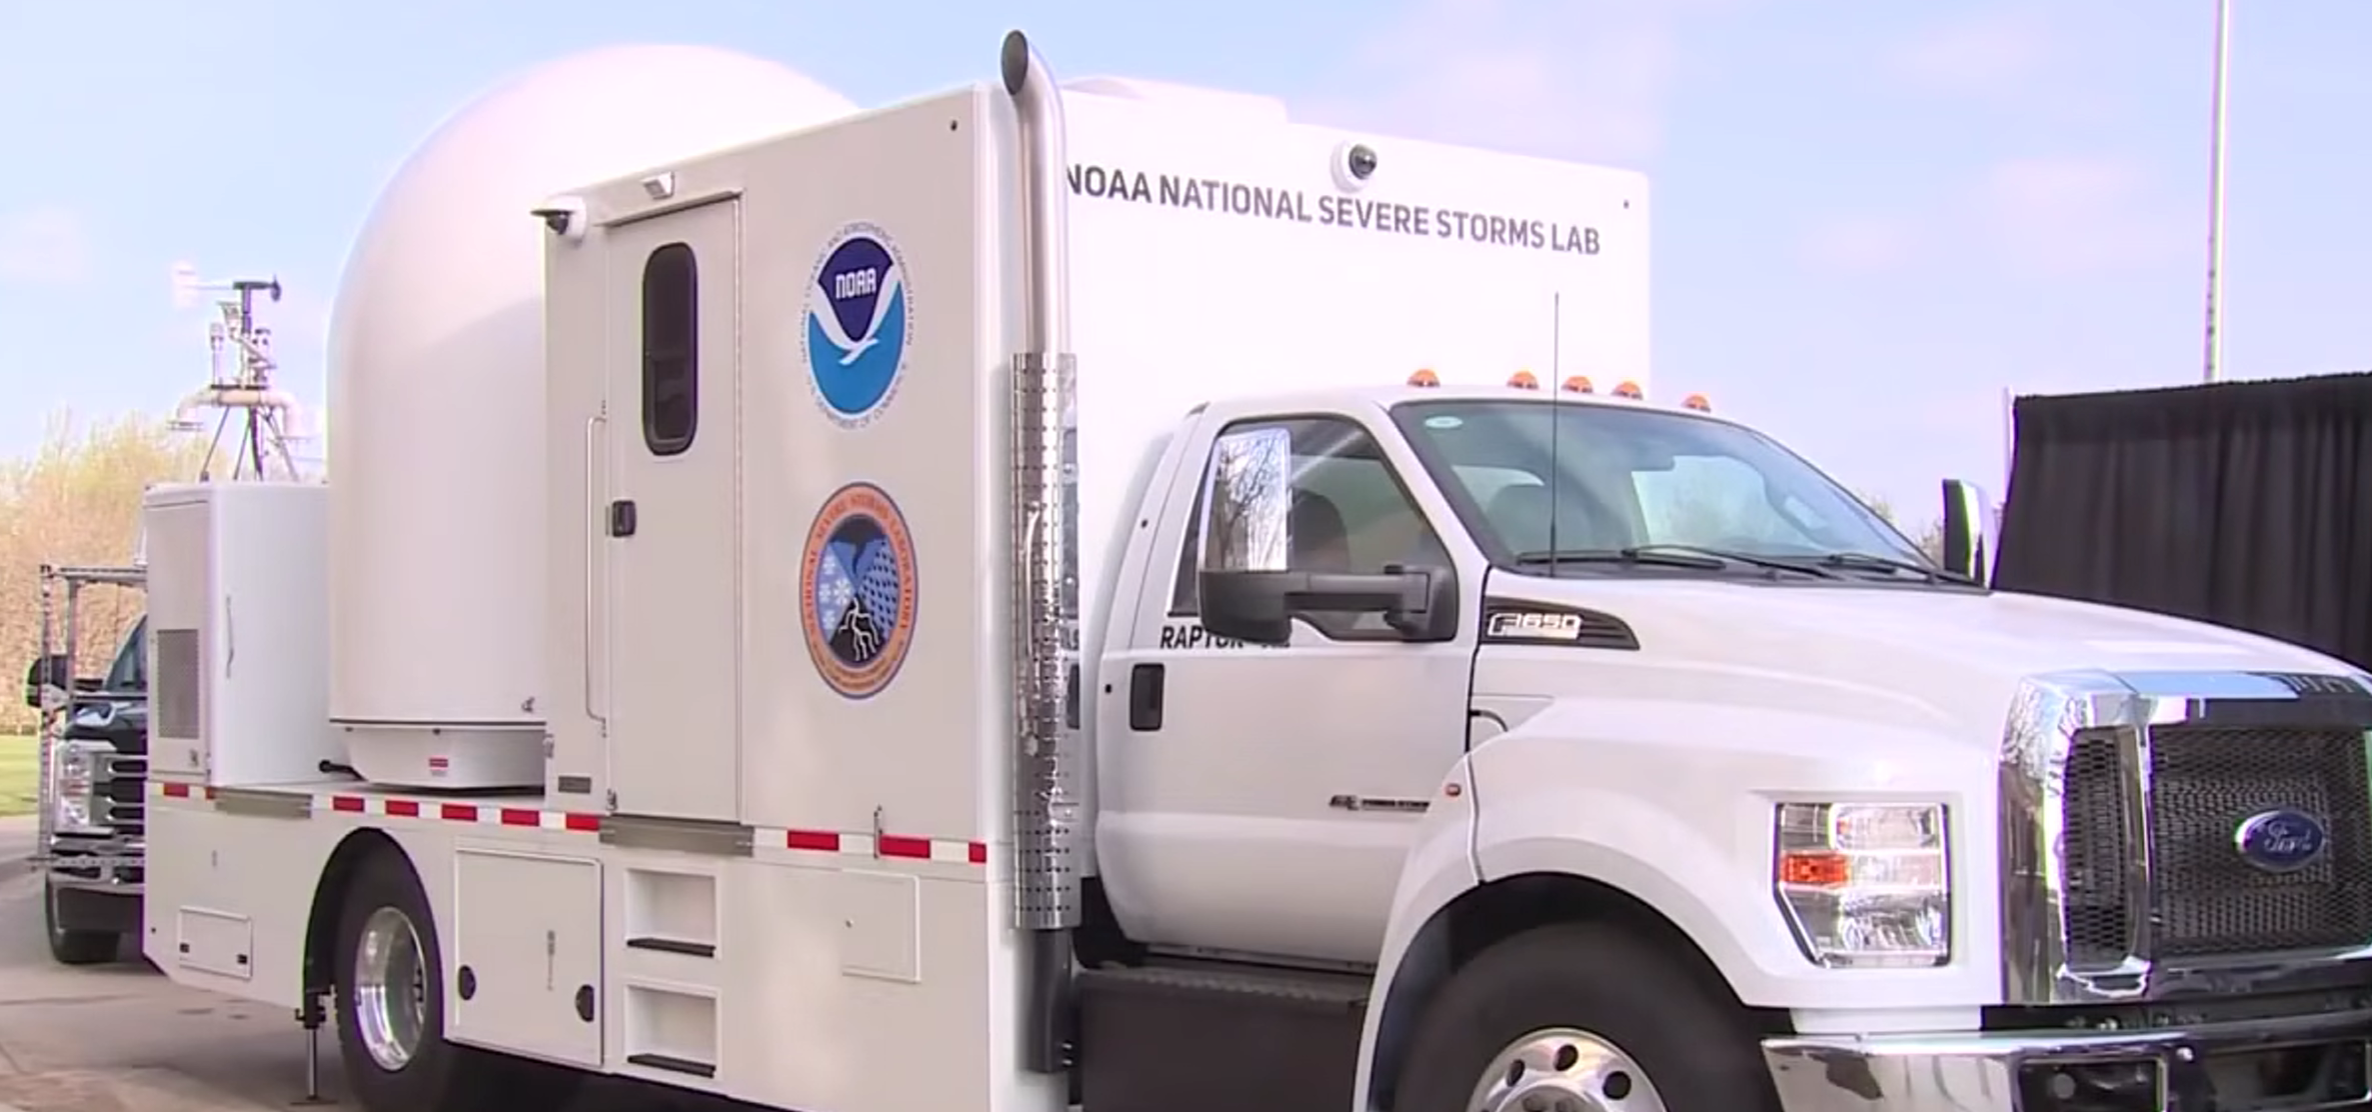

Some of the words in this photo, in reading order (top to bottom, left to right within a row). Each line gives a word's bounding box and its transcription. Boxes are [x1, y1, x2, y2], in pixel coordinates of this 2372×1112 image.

[1067, 164, 1152, 203] NOAA
[1160, 174, 1312, 222] NATIONAL
[1318, 195, 1430, 236] SEVERE
[1436, 209, 1545, 249] STORMS
[1551, 223, 1600, 255] LAB
[836, 268, 876, 299] NOAA
